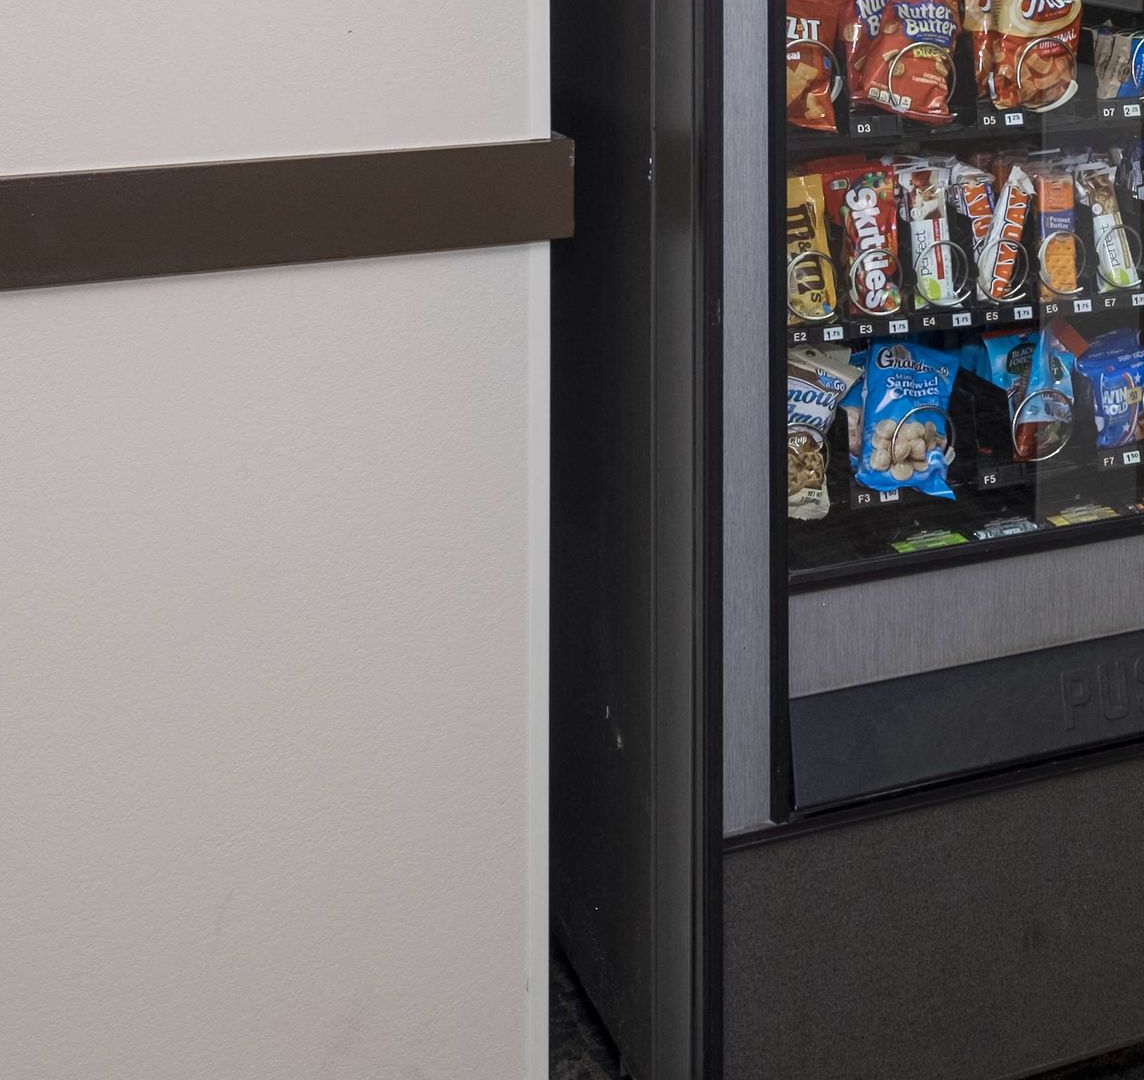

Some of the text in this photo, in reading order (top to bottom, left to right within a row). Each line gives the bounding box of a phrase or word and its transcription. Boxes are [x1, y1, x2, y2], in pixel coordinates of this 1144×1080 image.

[898, 3, 952, 20] Nutter
[905, 18, 957, 36] Butter
[1103, 108, 1115, 117] D7
[983, 116, 996, 125] D5
[857, 124, 871, 133] D3
[846, 187, 889, 309] Skittles
[1104, 298, 1116, 307] E7
[1046, 304, 1058, 313] E6
[986, 312, 999, 321] E5
[923, 318, 936, 326] E4
[859, 325, 873, 333] E3
[793, 332, 807, 341] E2
[834, 380, 845, 392] Go
[1103, 457, 1115, 466] F7
[984, 475, 996, 483] F5
[858, 495, 871, 503] F3
